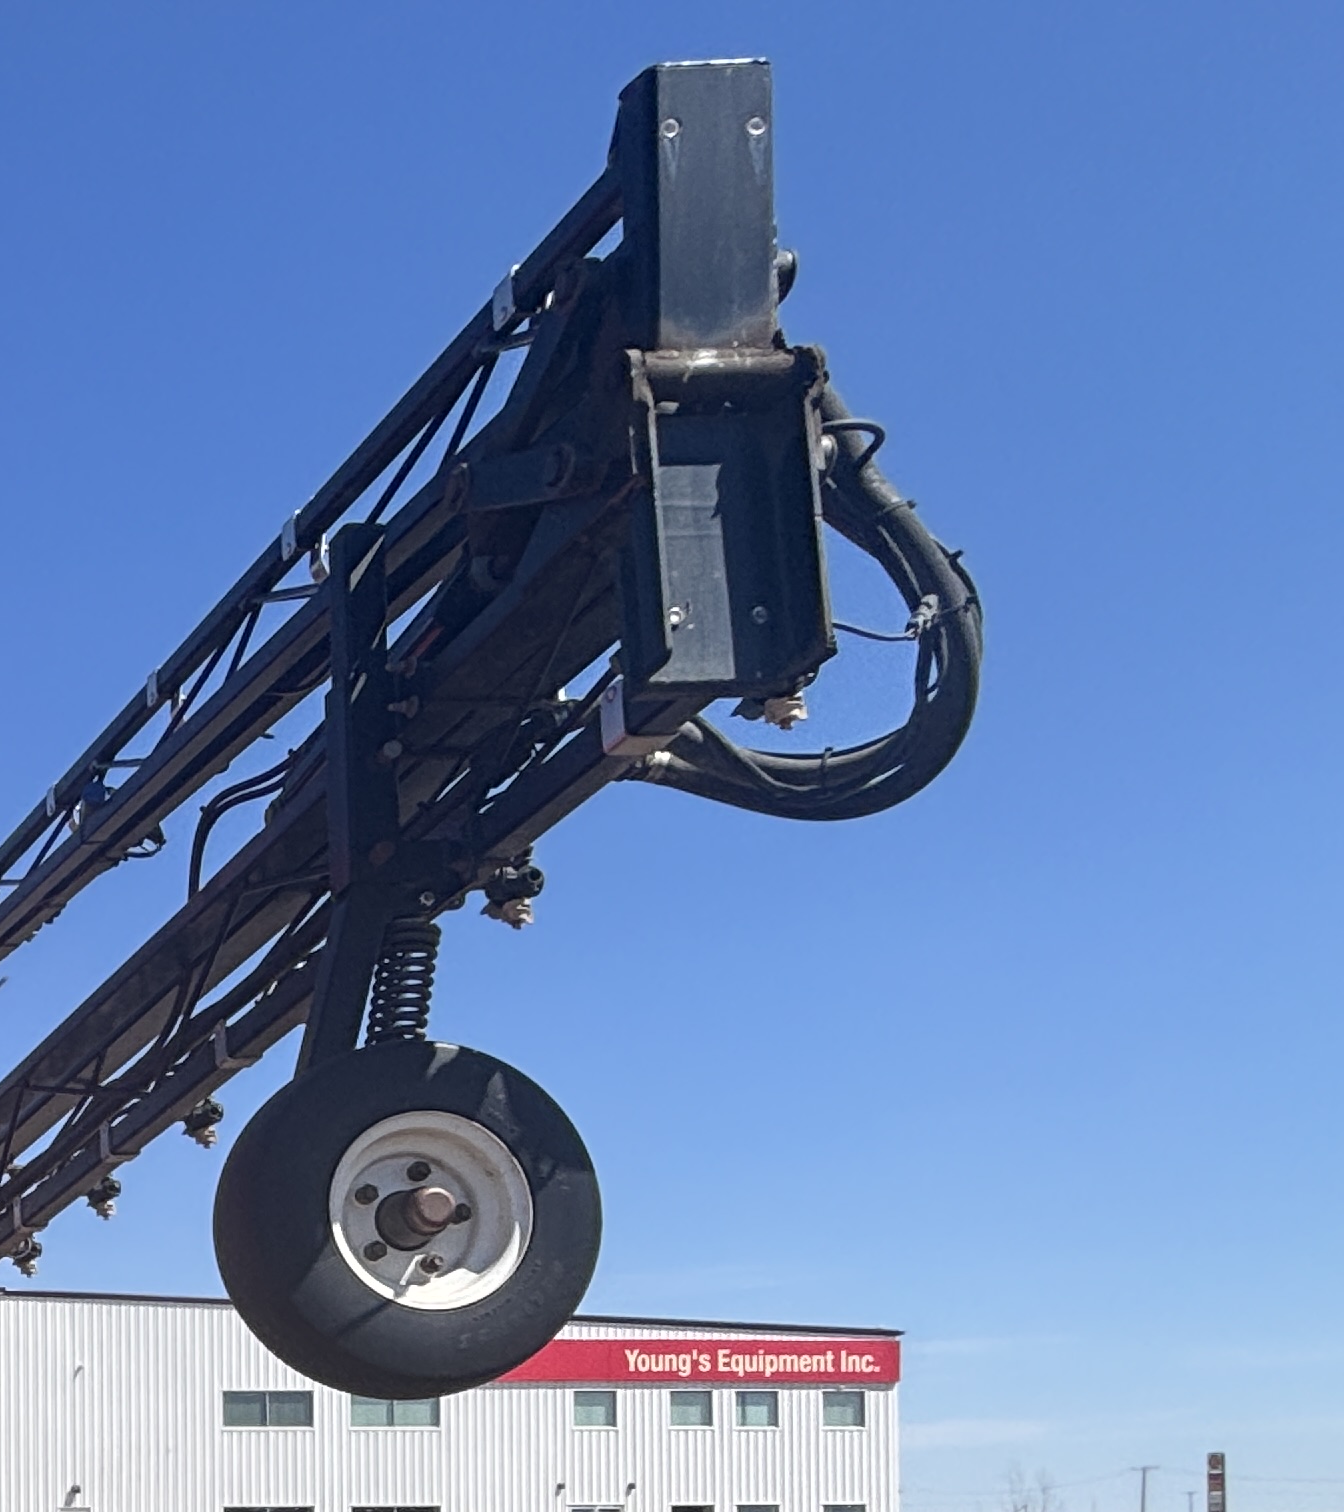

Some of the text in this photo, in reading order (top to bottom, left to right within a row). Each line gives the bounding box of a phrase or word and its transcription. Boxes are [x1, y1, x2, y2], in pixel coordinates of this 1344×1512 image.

[624, 1349, 881, 1377] Young's Equipment Inc.
